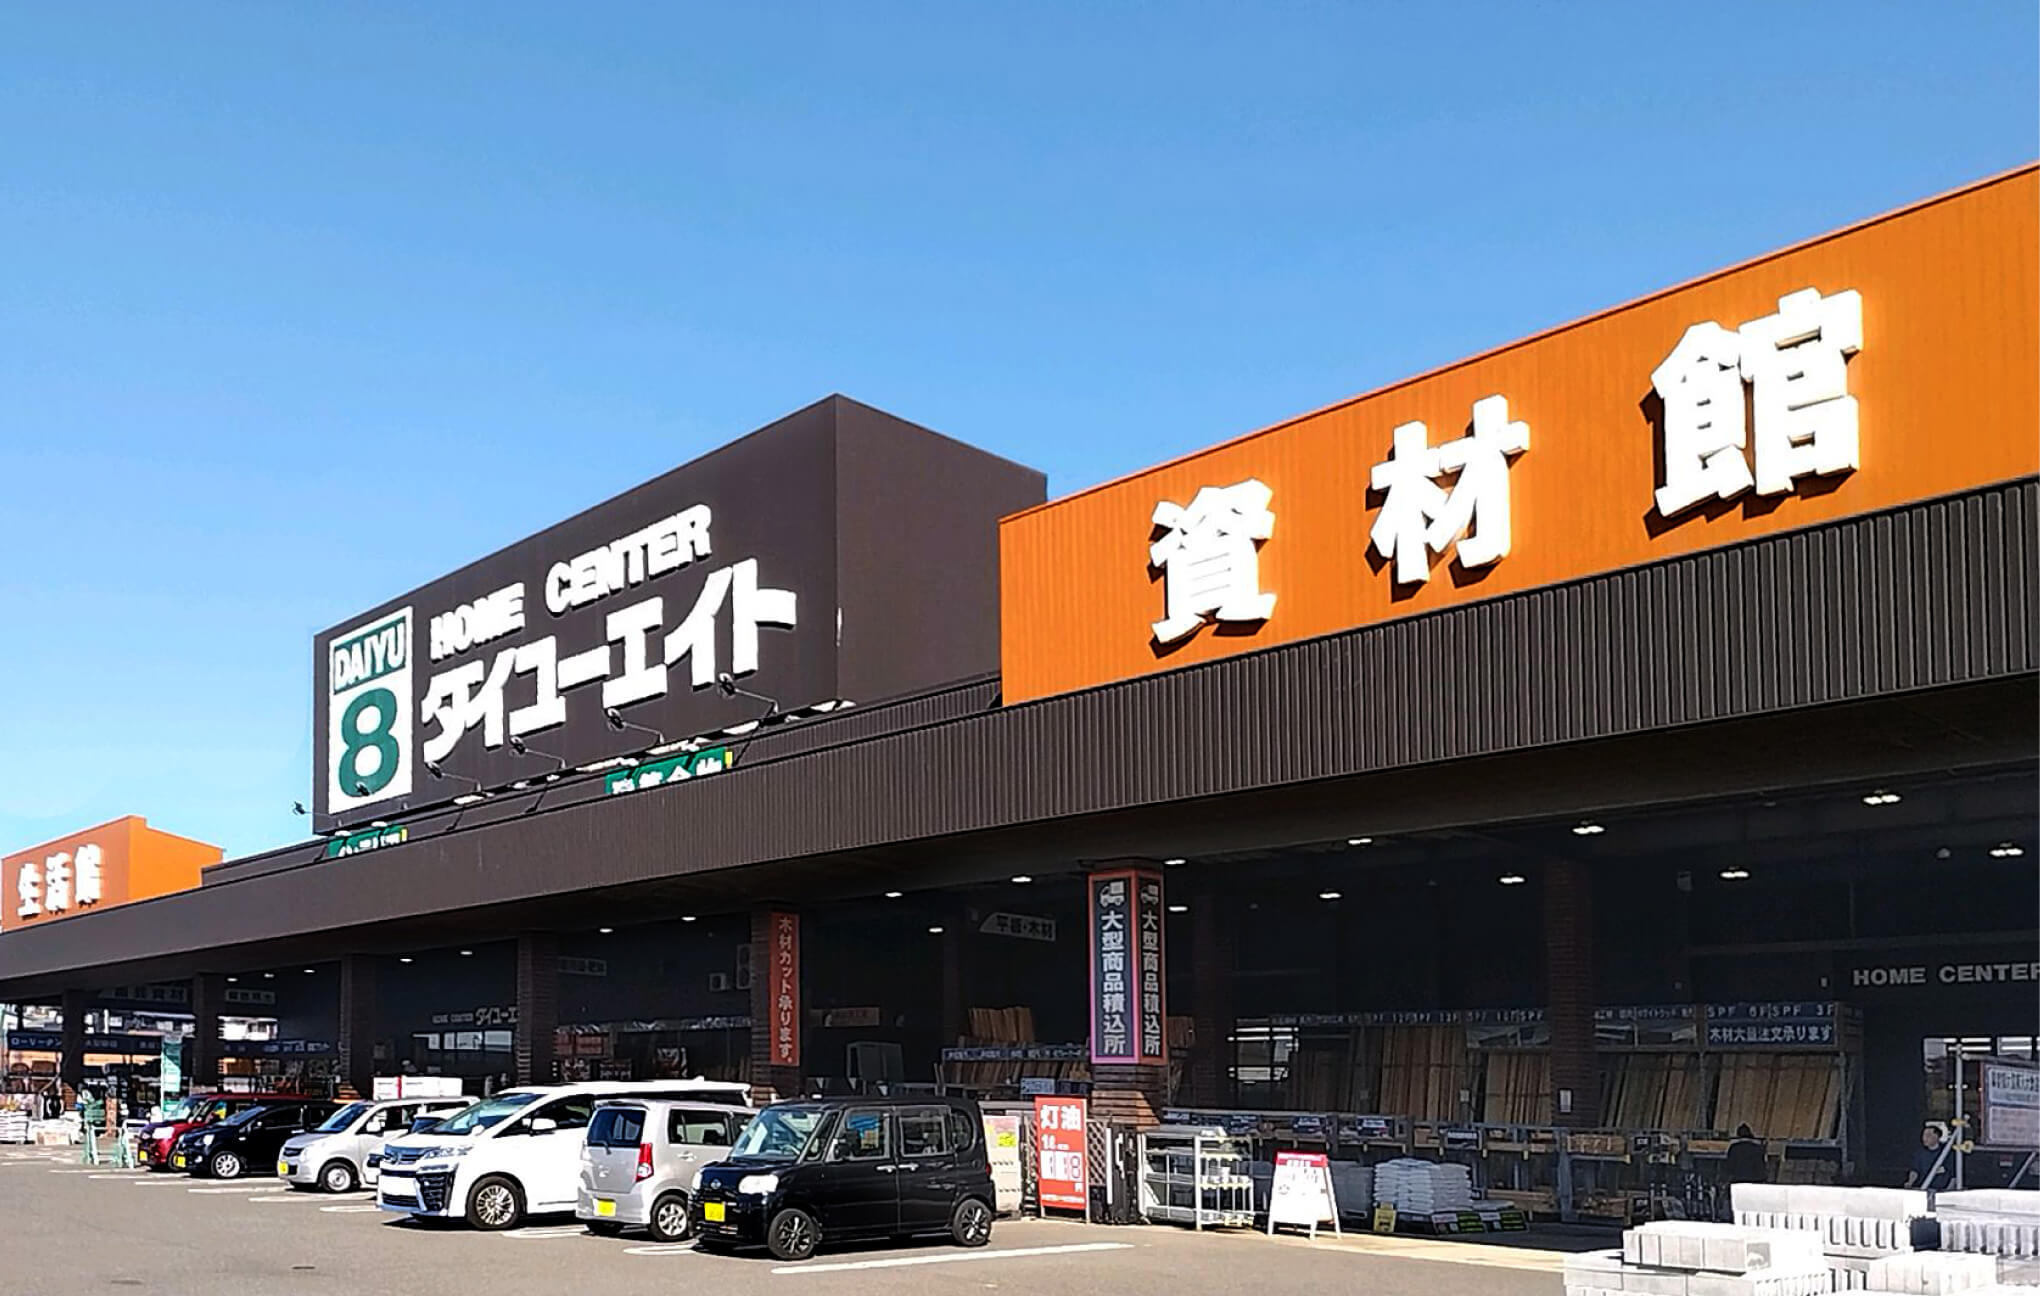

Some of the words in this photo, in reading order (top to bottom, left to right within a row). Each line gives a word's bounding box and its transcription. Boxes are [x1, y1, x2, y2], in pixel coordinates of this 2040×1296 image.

[1150, 287, 1863, 643] 資材館
[430, 582, 525, 662] HOME
[545, 503, 713, 614] CENTER
[334, 623, 405, 689] DAIYU
[421, 557, 797, 763] ダイユーエイト
[338, 687, 400, 797] 8
[1101, 910, 1126, 1055] 大型商品積込所
[1142, 910, 1161, 1056] 大型商品積込所
[1771, 1005, 1802, 1018] SPF
[1853, 967, 1927, 986] HOME
[1041, 1105, 1081, 1130] 灯油
